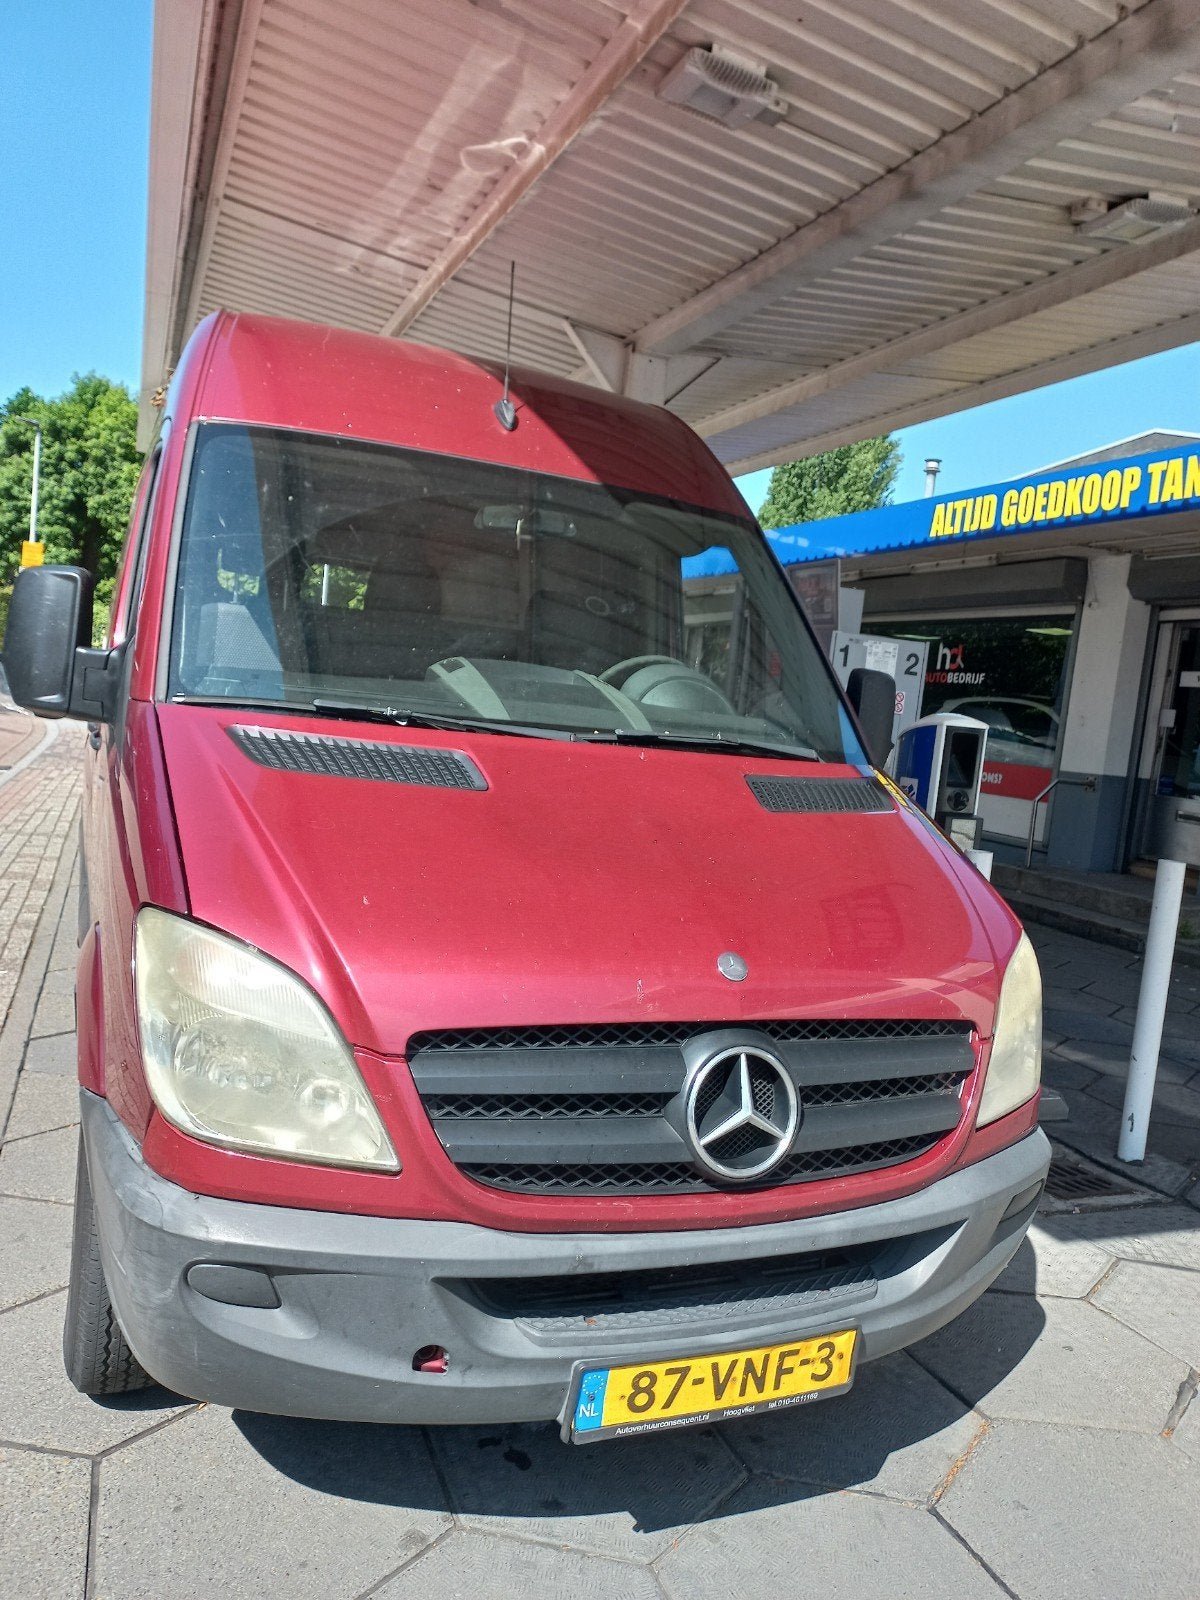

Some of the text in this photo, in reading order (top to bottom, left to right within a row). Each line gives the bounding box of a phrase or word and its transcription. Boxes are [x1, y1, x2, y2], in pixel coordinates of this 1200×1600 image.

[929, 454, 1200, 538] ALTIJD GOEDKOOP TAN
[839, 644, 850, 667] 1
[904, 653, 920, 676] 2
[626, 1340, 836, 1414] 87-VNF-3
[578, 1402, 600, 1418] NL
[614, 1412, 710, 1436] Autoverhuurconsequent.nl
